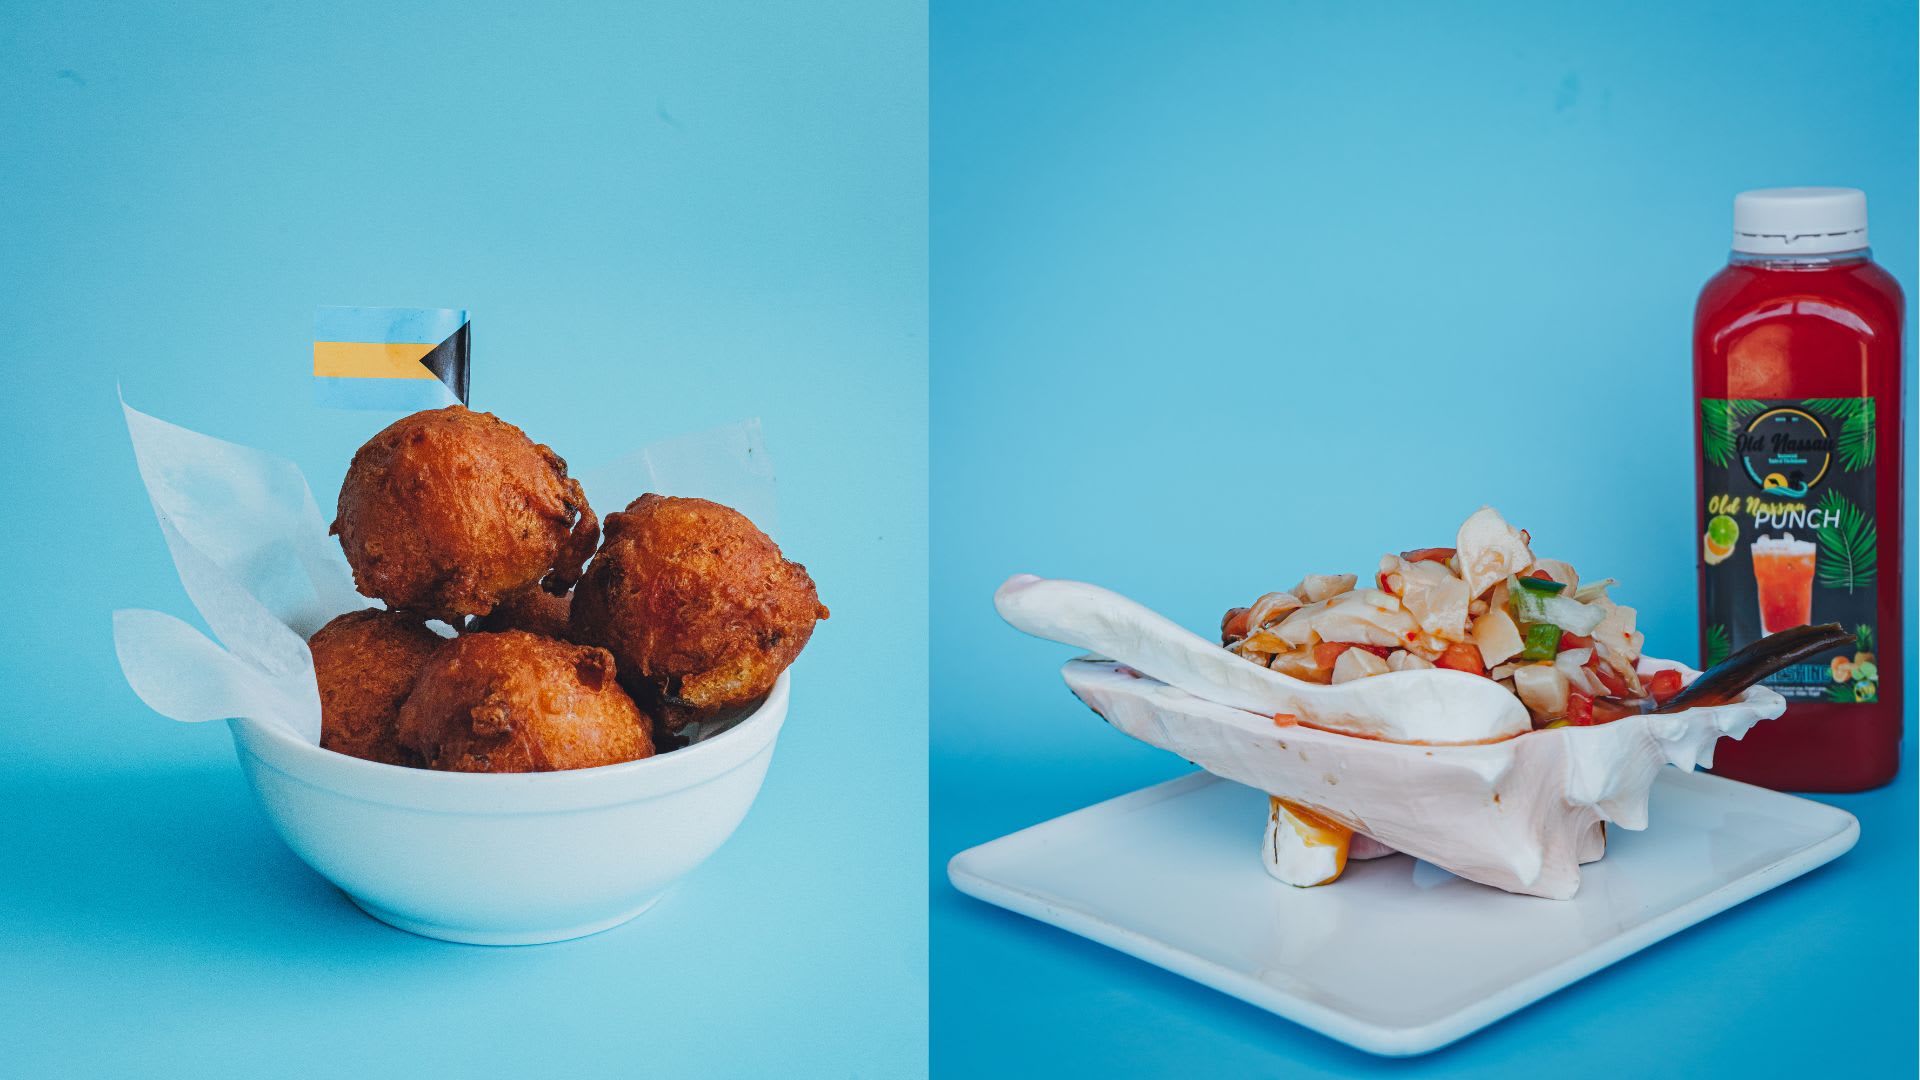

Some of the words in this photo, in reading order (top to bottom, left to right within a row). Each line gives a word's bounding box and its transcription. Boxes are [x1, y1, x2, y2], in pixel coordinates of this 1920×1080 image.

[1736, 434, 1764, 452] Old
[1771, 433, 1833, 452] Nassau
[1709, 494, 1741, 515] Old
[1746, 496, 1806, 516] Nassau
[1754, 508, 1841, 529] PUNCH
